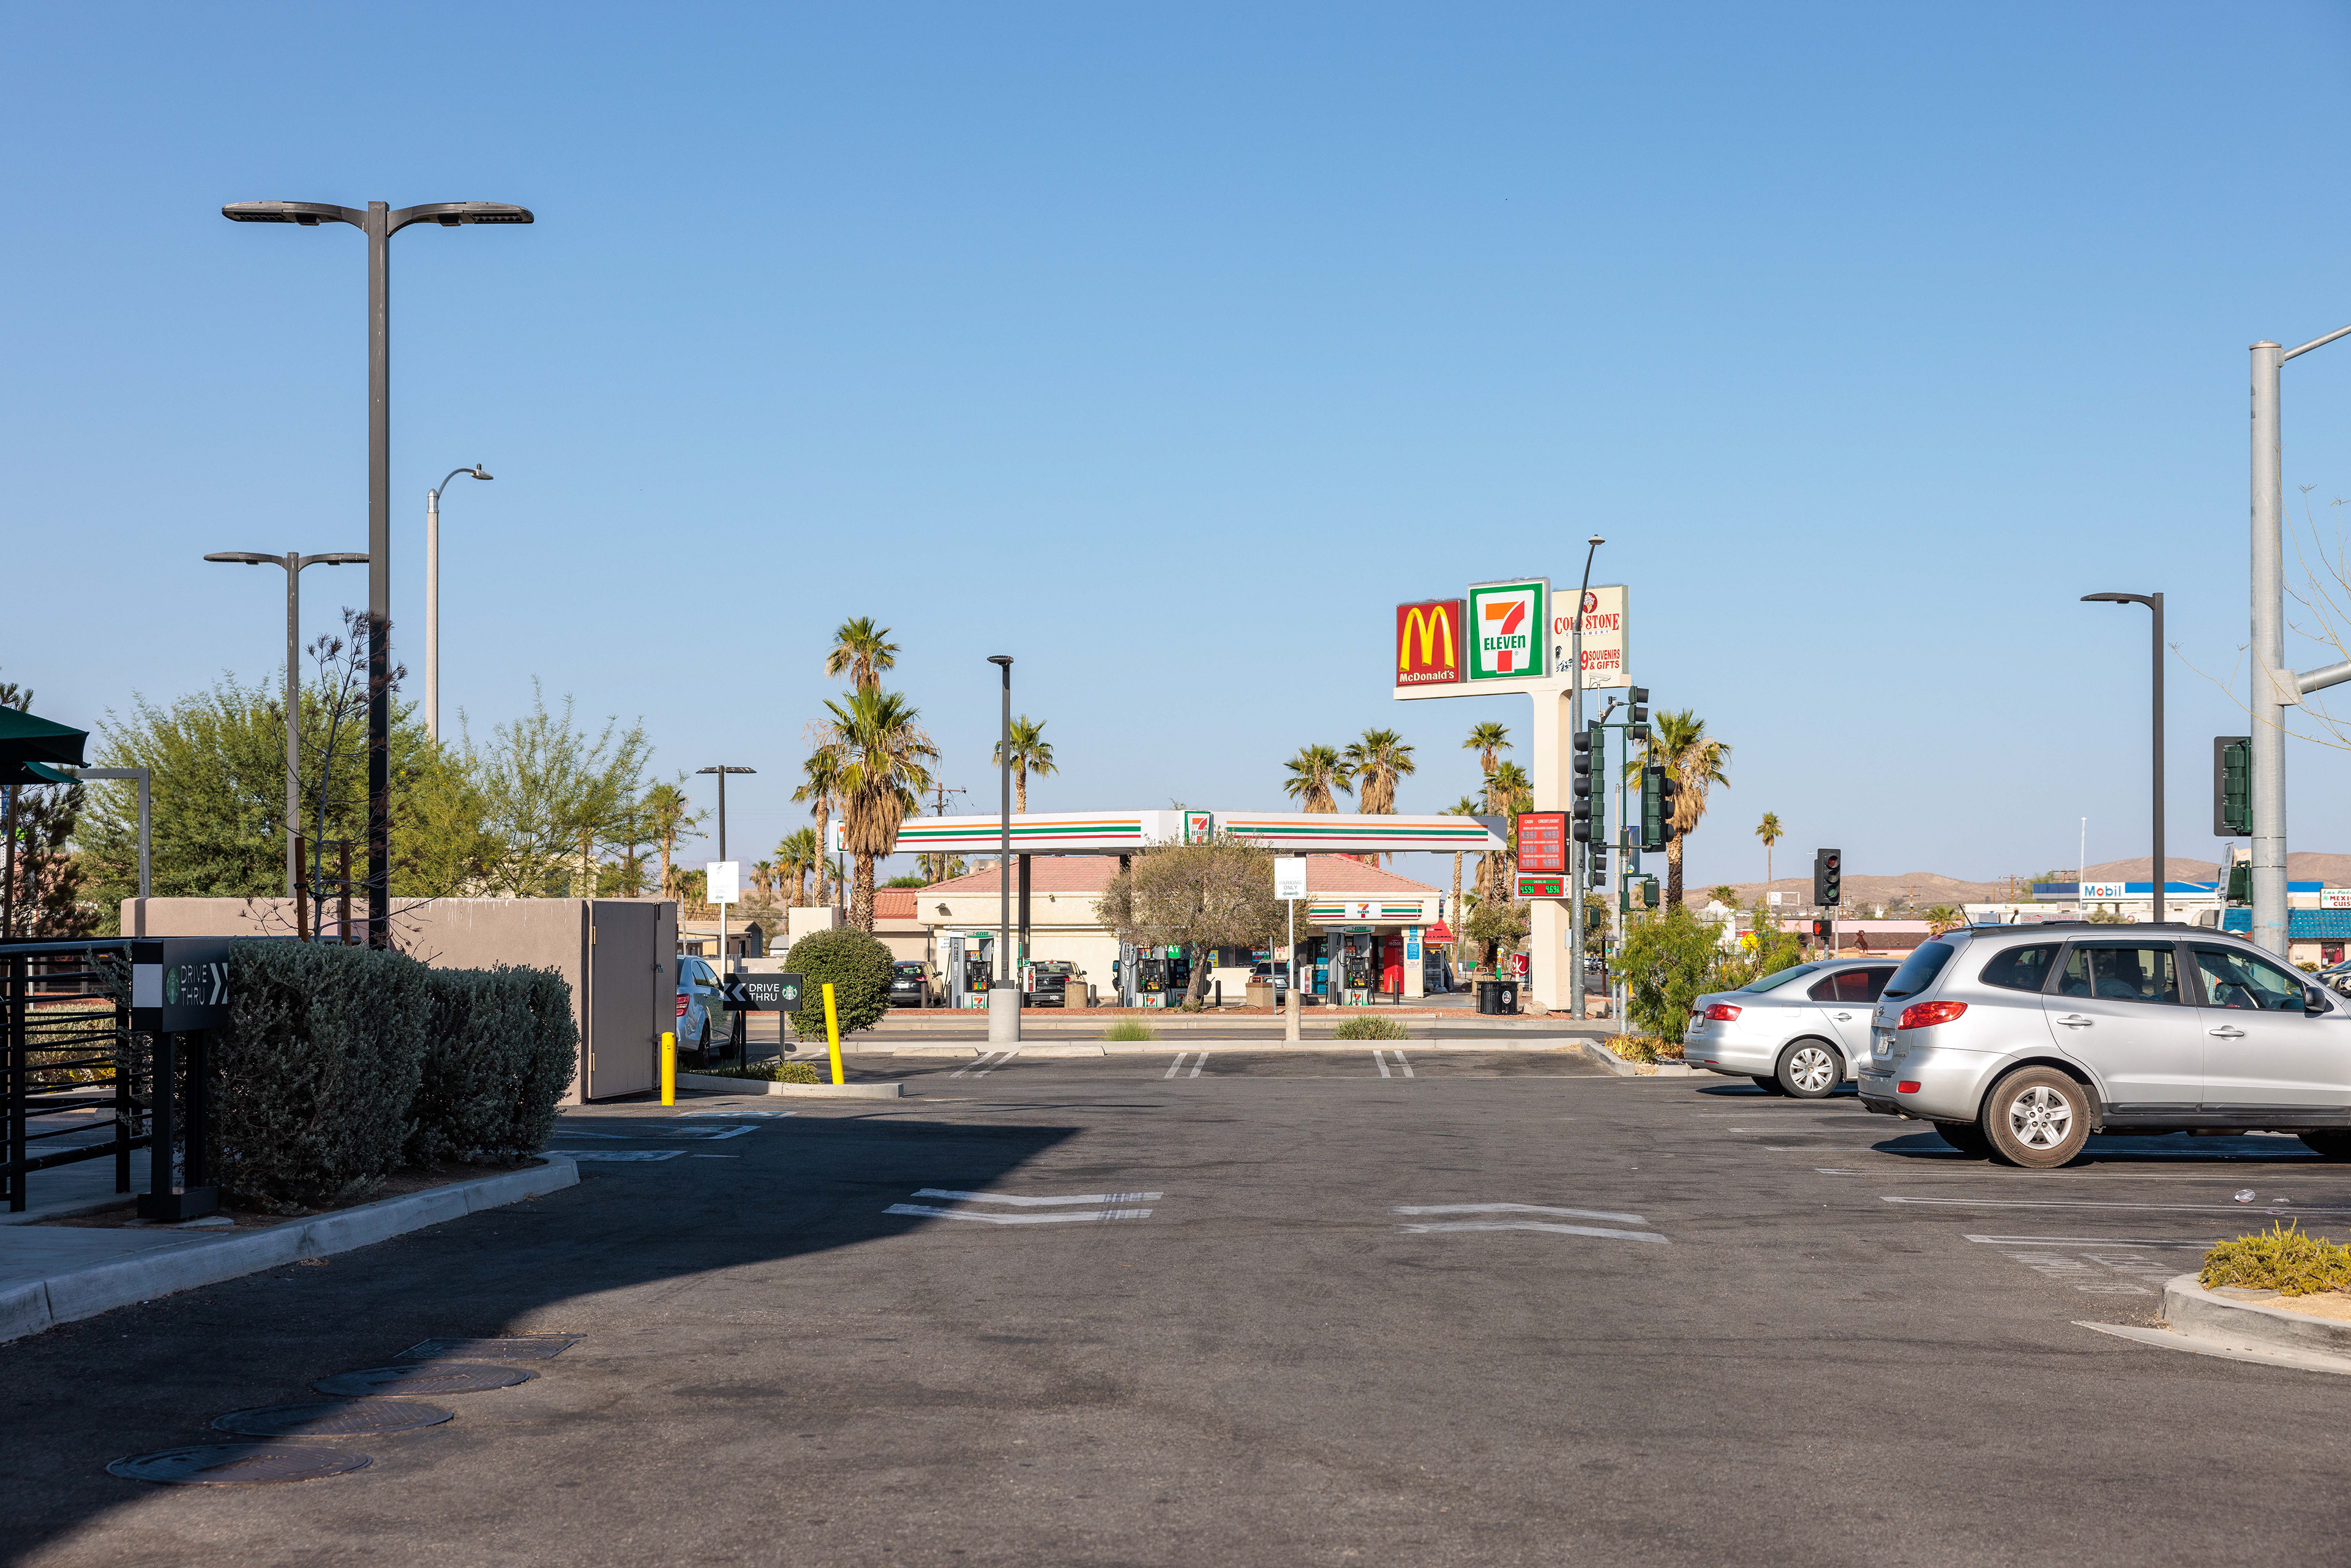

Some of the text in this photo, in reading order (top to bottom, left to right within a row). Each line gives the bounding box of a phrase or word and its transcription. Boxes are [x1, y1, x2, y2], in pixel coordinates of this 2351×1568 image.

[1586, 613, 1619, 630] STONE
[1485, 600, 1525, 672] 7
[1589, 649, 1620, 661] SOUVENIRS
[1597, 660, 1619, 670] GIFTS
[1399, 670, 1455, 682] McDonald's
[2085, 885, 2121, 896] Mobil
[181, 964, 207, 984] DRIVE
[181, 987, 205, 1006] THRU
